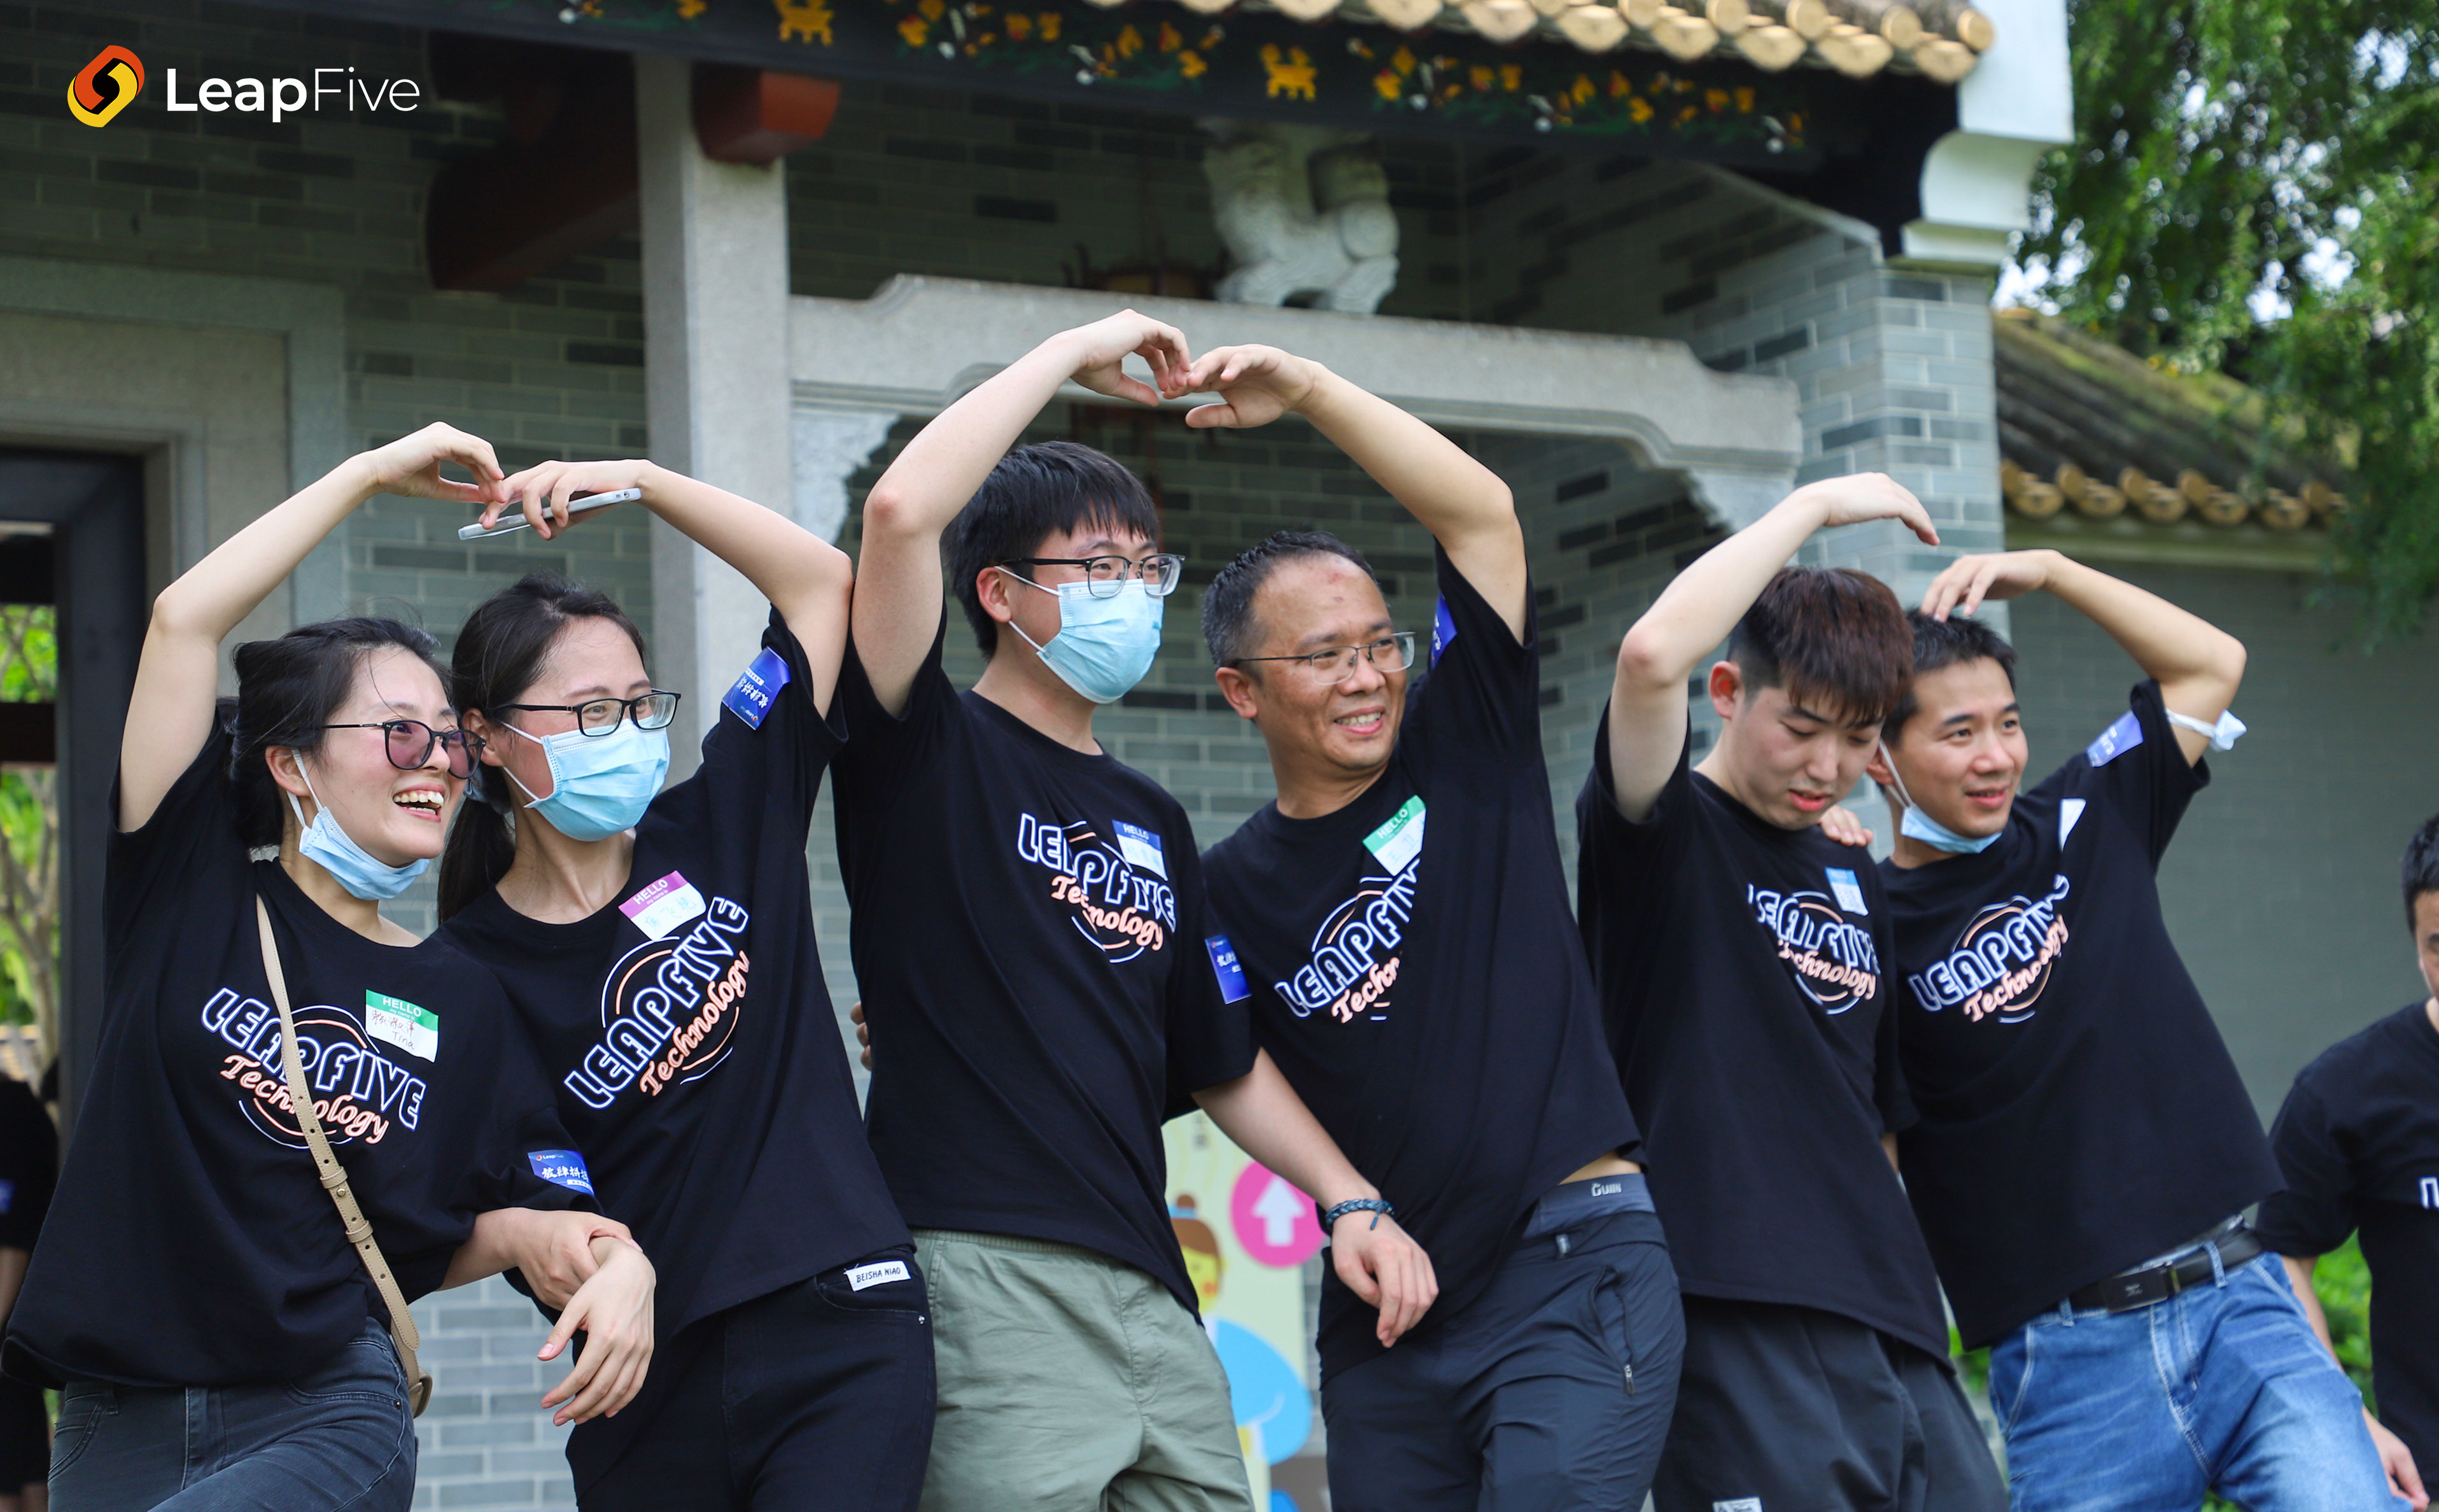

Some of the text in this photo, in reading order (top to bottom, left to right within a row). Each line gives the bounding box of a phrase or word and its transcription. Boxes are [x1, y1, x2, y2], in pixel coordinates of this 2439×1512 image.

[1123, 823, 1149, 840] HELLO
[1377, 808, 1408, 839] HELLO
[633, 879, 668, 905] HELLO
[1051, 874, 1164, 951] Tecnology
[383, 997, 422, 1018] HELLO
[564, 896, 749, 1110] LEAPFIVE
[392, 1030, 415, 1050] Tina
[220, 1054, 389, 1144] Techology
[856, 1268, 901, 1283] BEISHA NIAO
